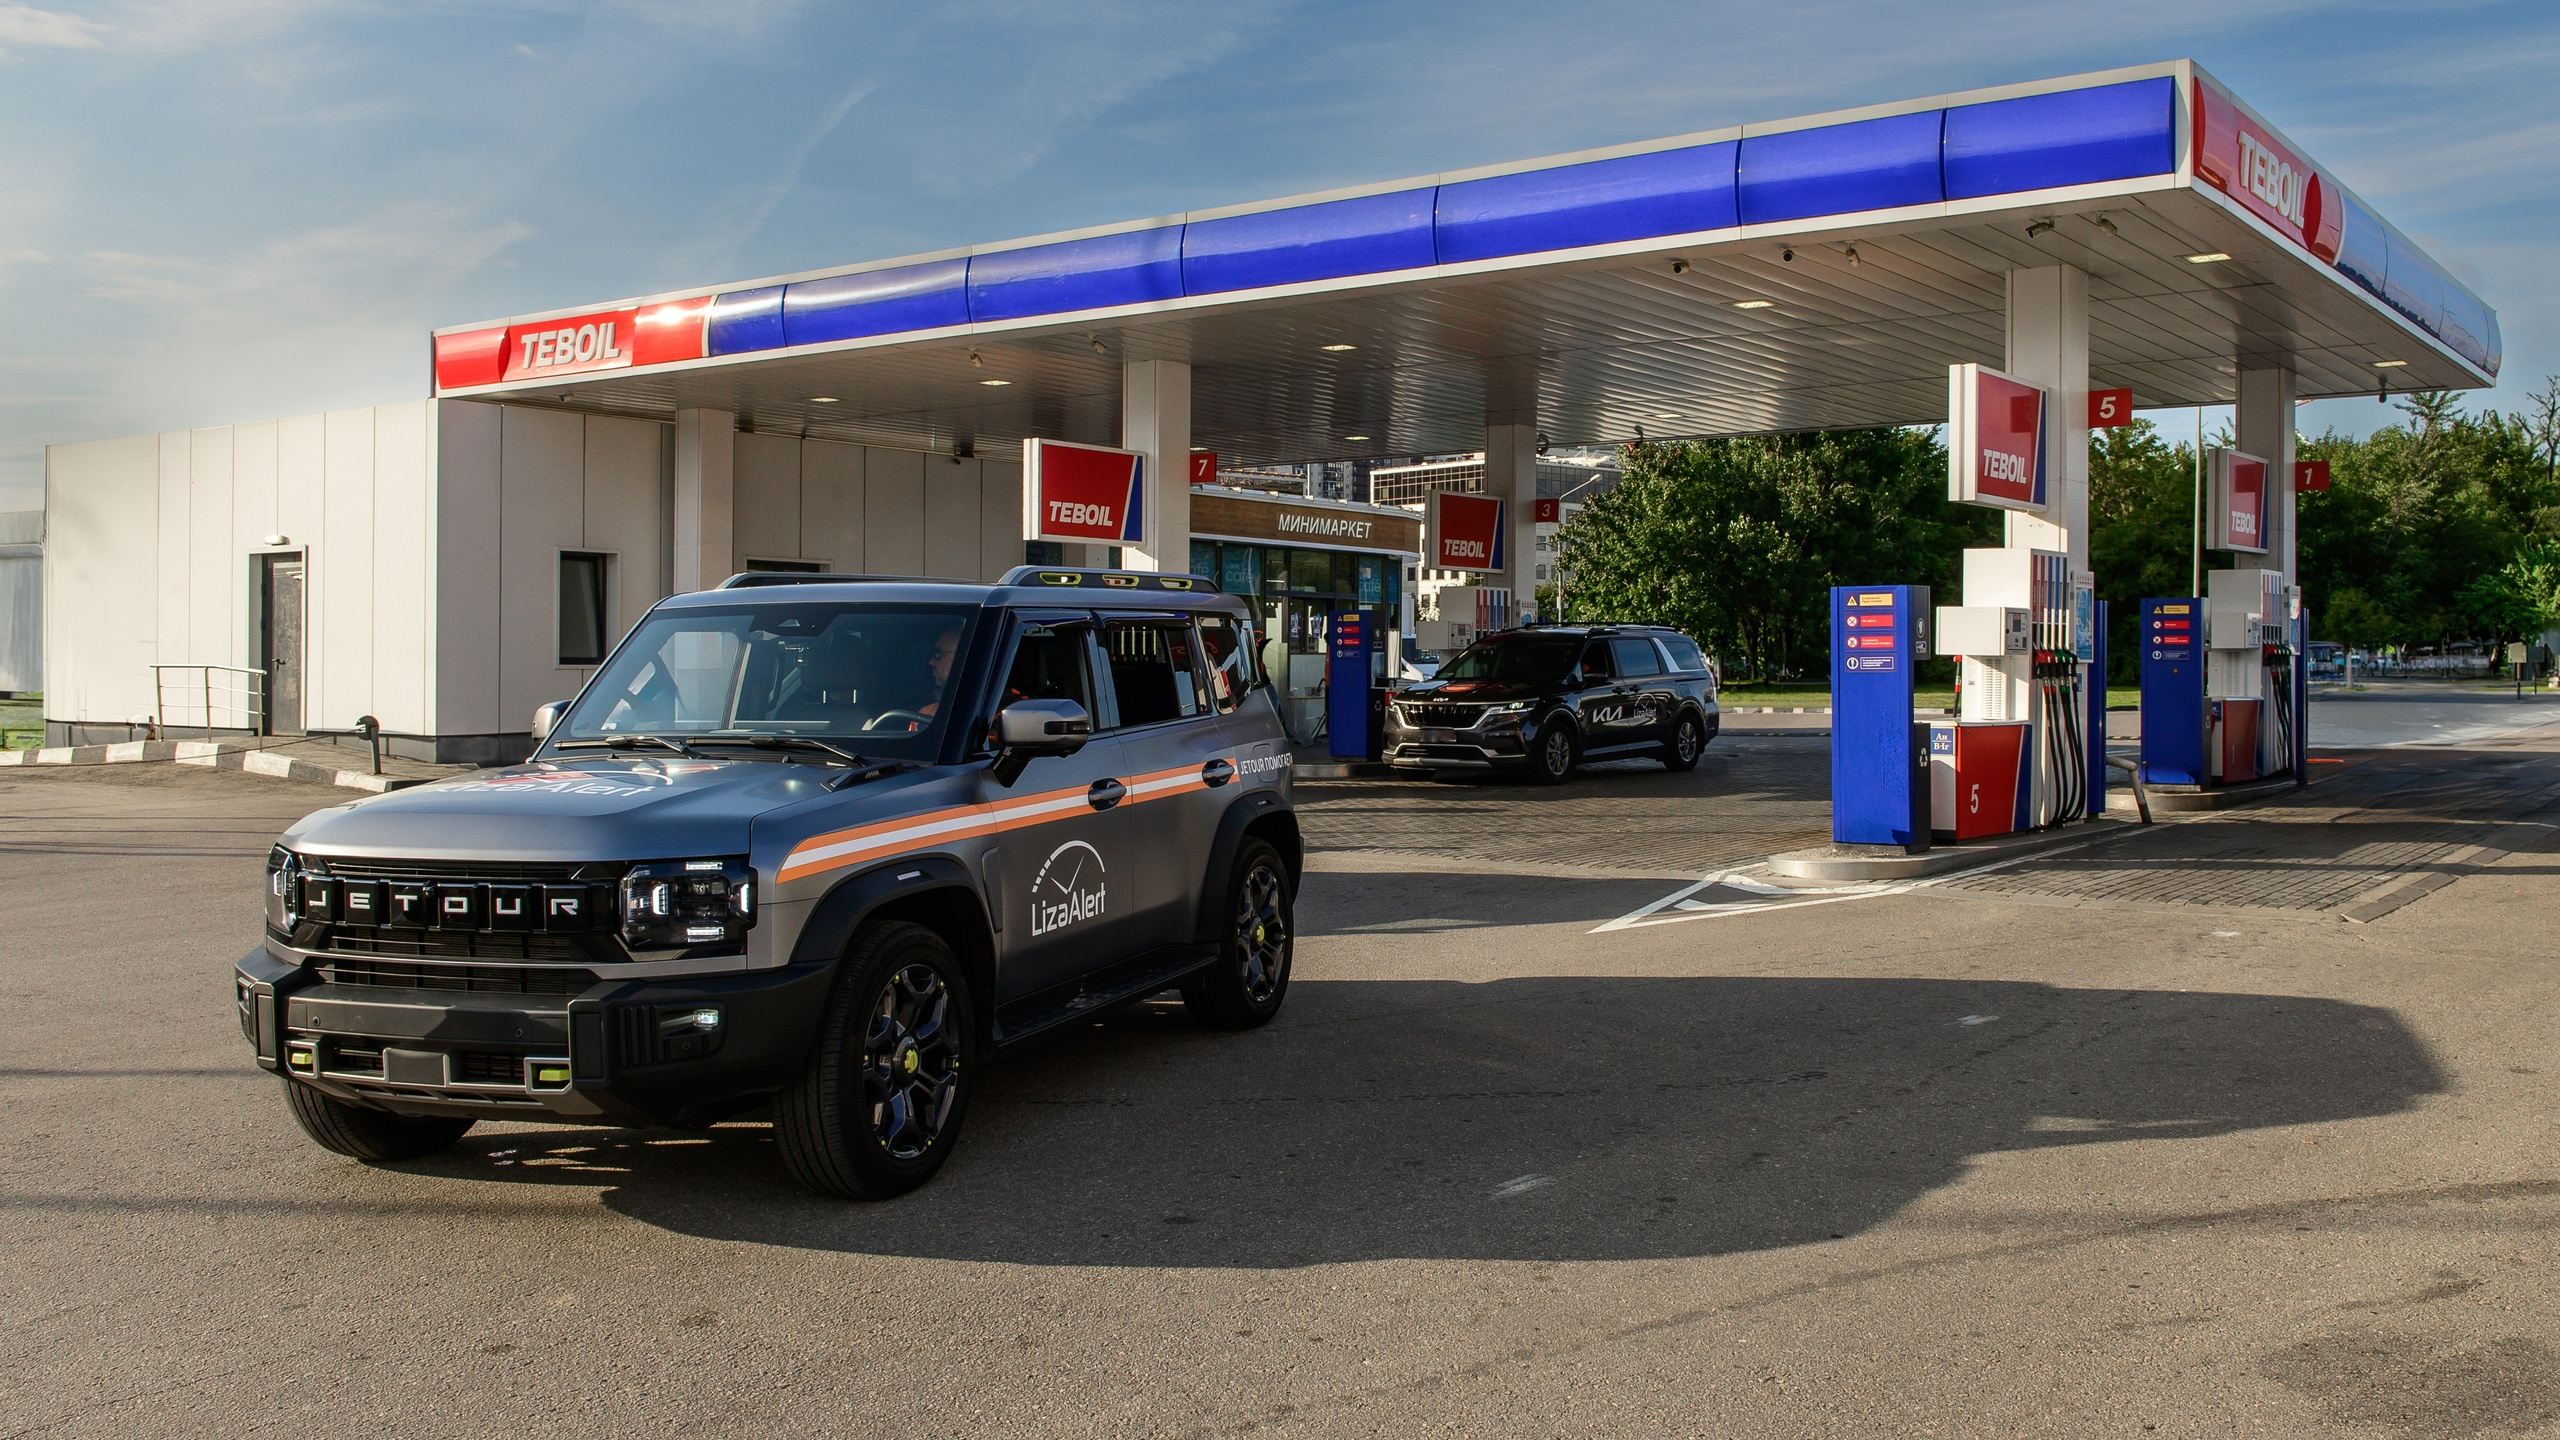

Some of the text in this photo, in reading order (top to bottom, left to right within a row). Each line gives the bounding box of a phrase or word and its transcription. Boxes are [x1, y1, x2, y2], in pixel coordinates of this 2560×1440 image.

[2238, 130, 2304, 229] TEBOIL
[521, 321, 621, 369] TEBOIL
[2099, 396, 2116, 419] 5
[1198, 459, 1208, 477] 7
[1983, 448, 2027, 485] TEBOIL
[2304, 467, 2313, 485] 1
[1050, 500, 1113, 527] TEBOIL
[1541, 503, 1551, 518] 3
[2231, 510, 2256, 535] TEBOIL
[1278, 513, 1372, 539] МИНИМАРКЕТ
[1444, 538, 1485, 559] TEBOIL
[1240, 758, 1266, 775] JETOUR
[1970, 783, 1979, 814] 5
[308, 890, 579, 916] JETOUR
[1032, 882, 1106, 937] LizaAlert
